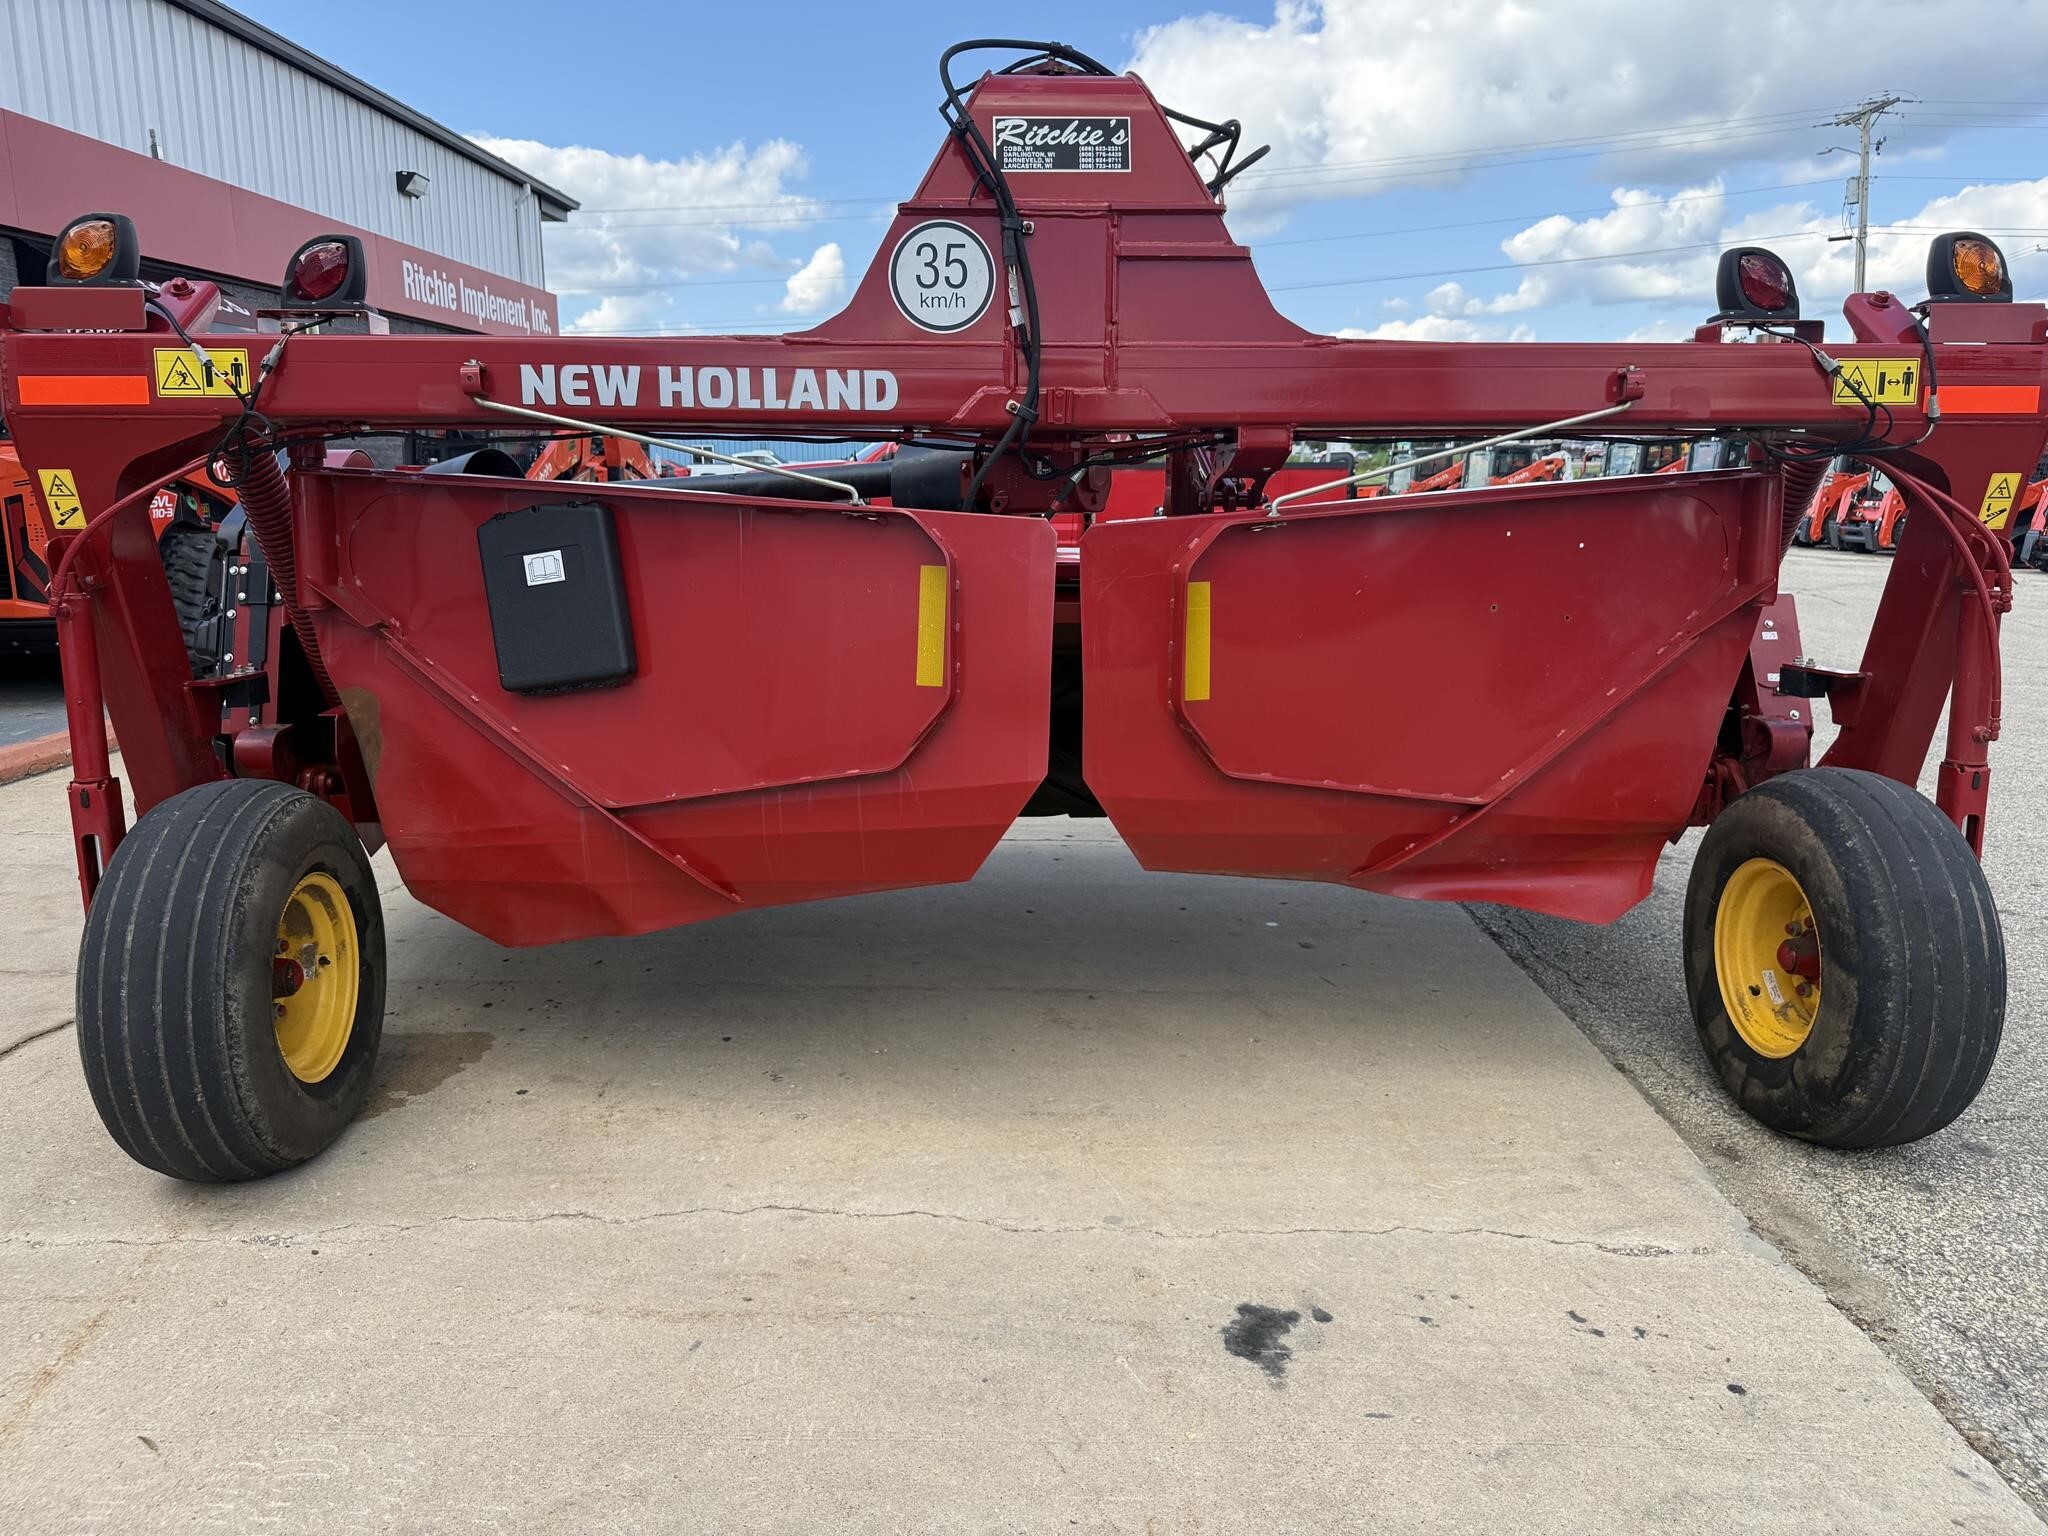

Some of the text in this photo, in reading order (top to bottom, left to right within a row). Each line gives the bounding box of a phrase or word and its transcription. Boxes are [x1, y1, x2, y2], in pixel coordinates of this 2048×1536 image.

[996, 119, 1128, 146] Ritchie's
[915, 242, 968, 289] 35
[402, 259, 552, 336] Ritchie Implement, Inc.
[920, 292, 966, 308] km/h
[519, 364, 900, 412] NEW HOLLAND
[150, 495, 173, 508] SVL
[152, 507, 174, 519] 110-3
